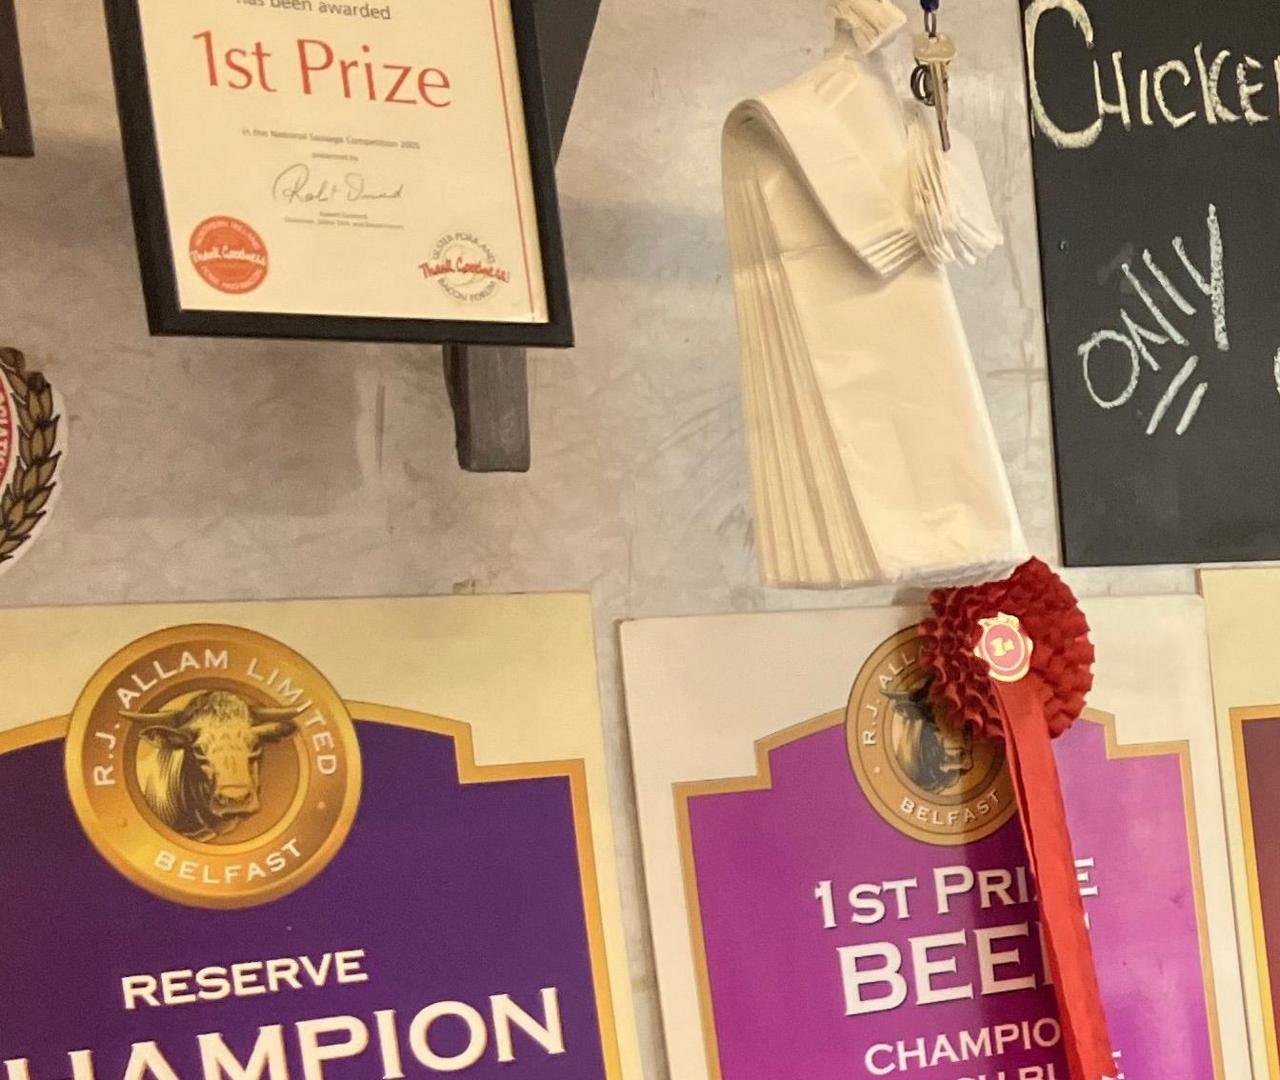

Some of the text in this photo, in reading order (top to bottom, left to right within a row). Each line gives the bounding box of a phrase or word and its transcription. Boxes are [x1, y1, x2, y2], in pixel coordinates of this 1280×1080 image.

[318, 2, 391, 20] awarded
[192, 30, 452, 107] 1st Prize
[877, 645, 926, 690] ALL
[115, 648, 230, 709] ALLAM
[246, 656, 338, 776] LIMITED
[900, 788, 1001, 826] BELFAST
[153, 838, 303, 885] BELFAST
[814, 876, 918, 929] 1ST
[121, 948, 370, 1010] RESERVE
[863, 1016, 1062, 1076] CHAMPIO
